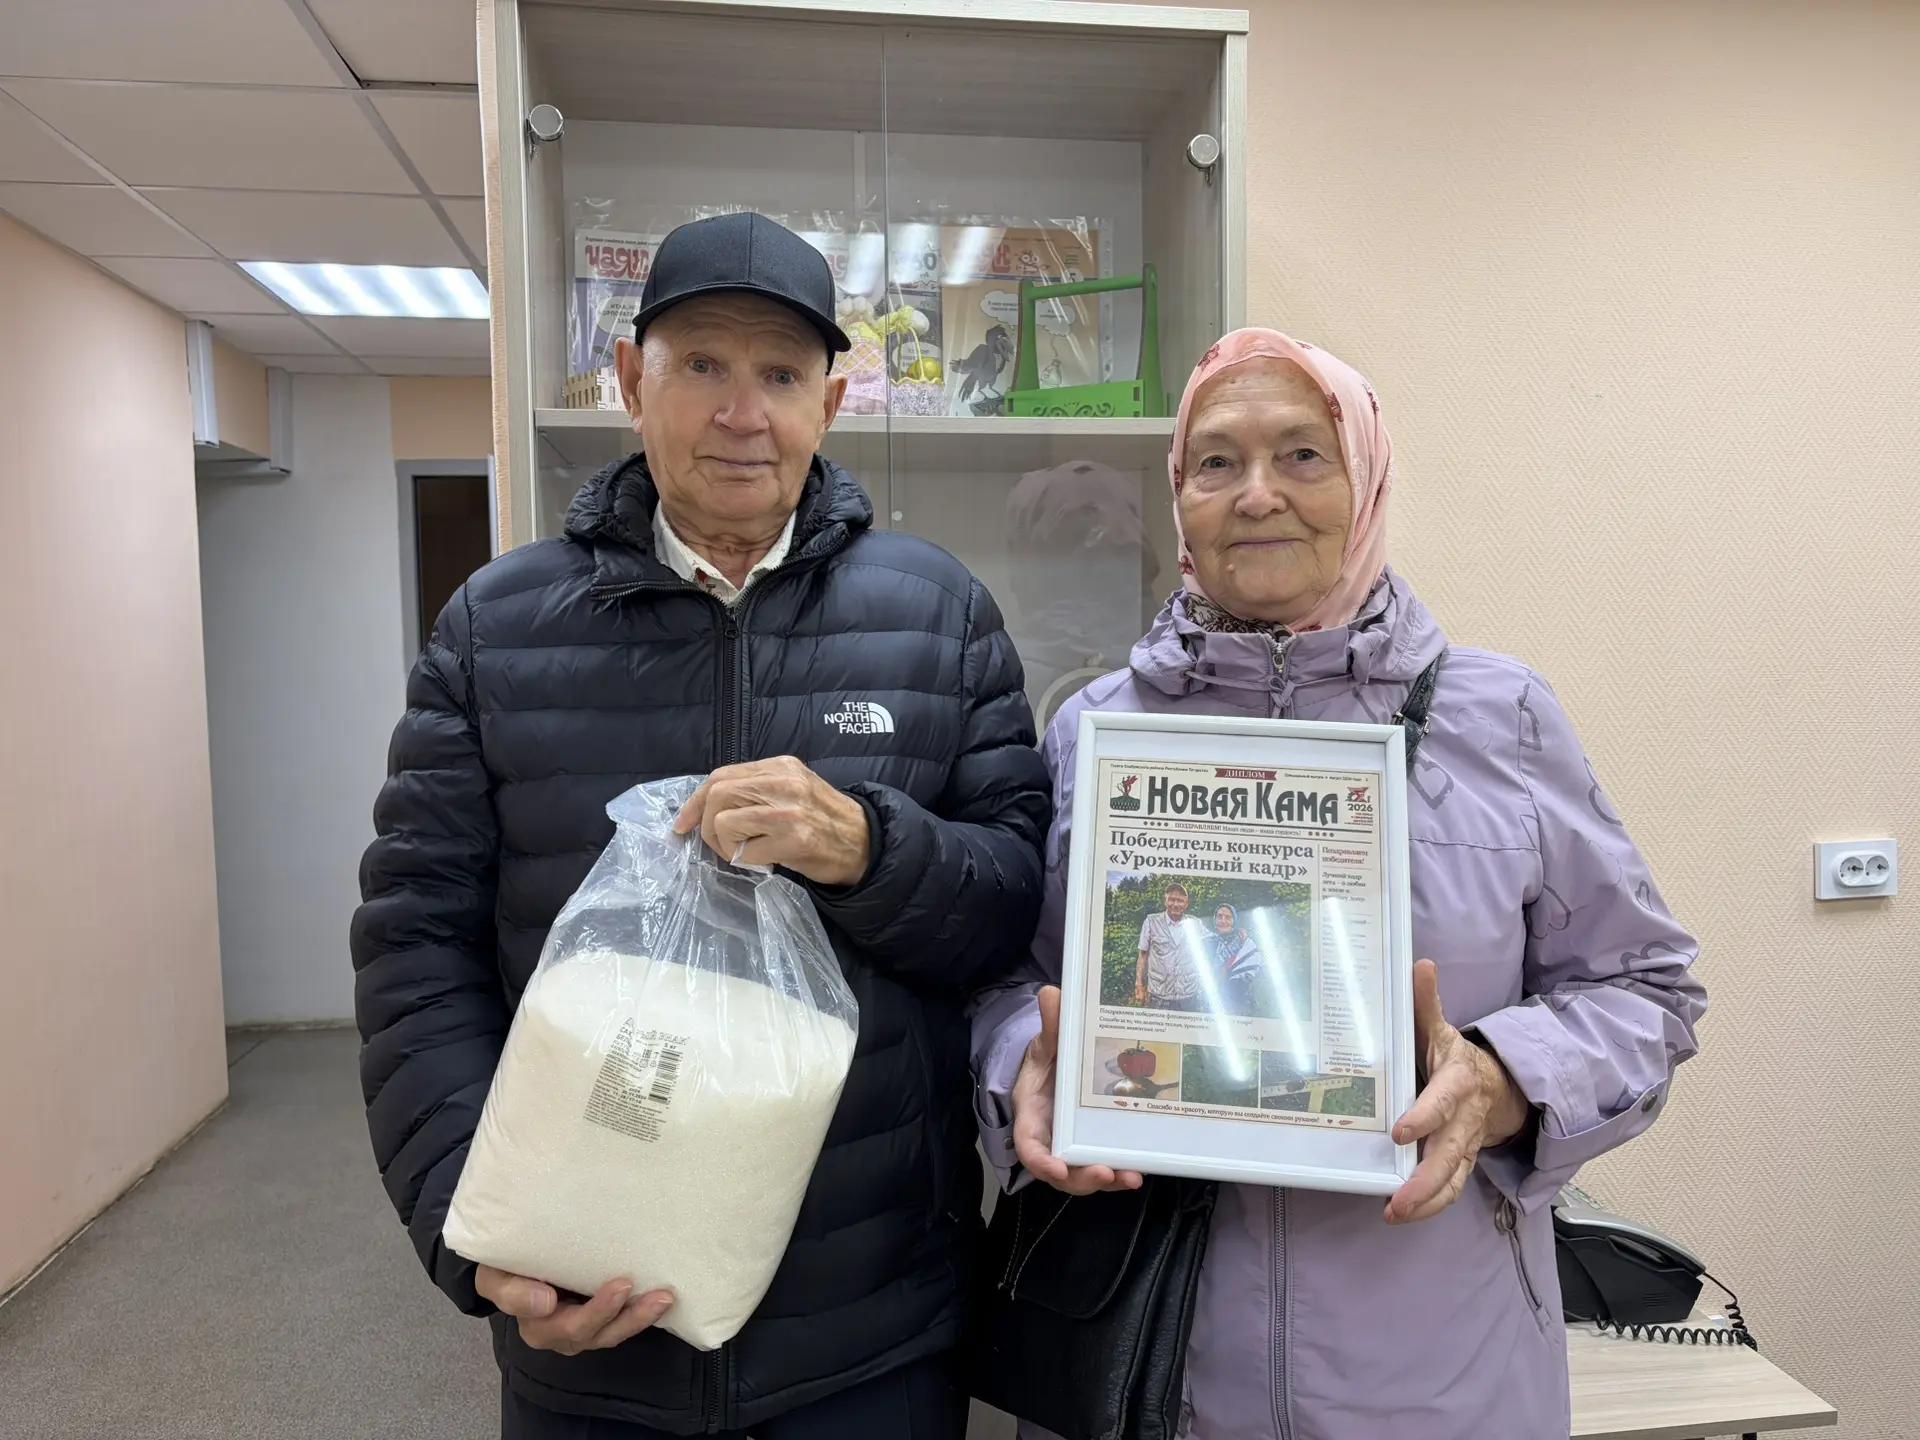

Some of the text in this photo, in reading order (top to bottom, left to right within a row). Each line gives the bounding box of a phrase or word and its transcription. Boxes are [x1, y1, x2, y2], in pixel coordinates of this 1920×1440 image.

[842, 702, 868, 712] THE
[824, 712, 870, 724] NORTH
[840, 723, 871, 734] FACE
[1224, 769, 1265, 779] ДИПЛОМ
[1347, 803, 1373, 812] 2026
[1111, 831, 1314, 859] Победитель конкурса
[1109, 850, 1308, 880] «Урожайный кадр»
